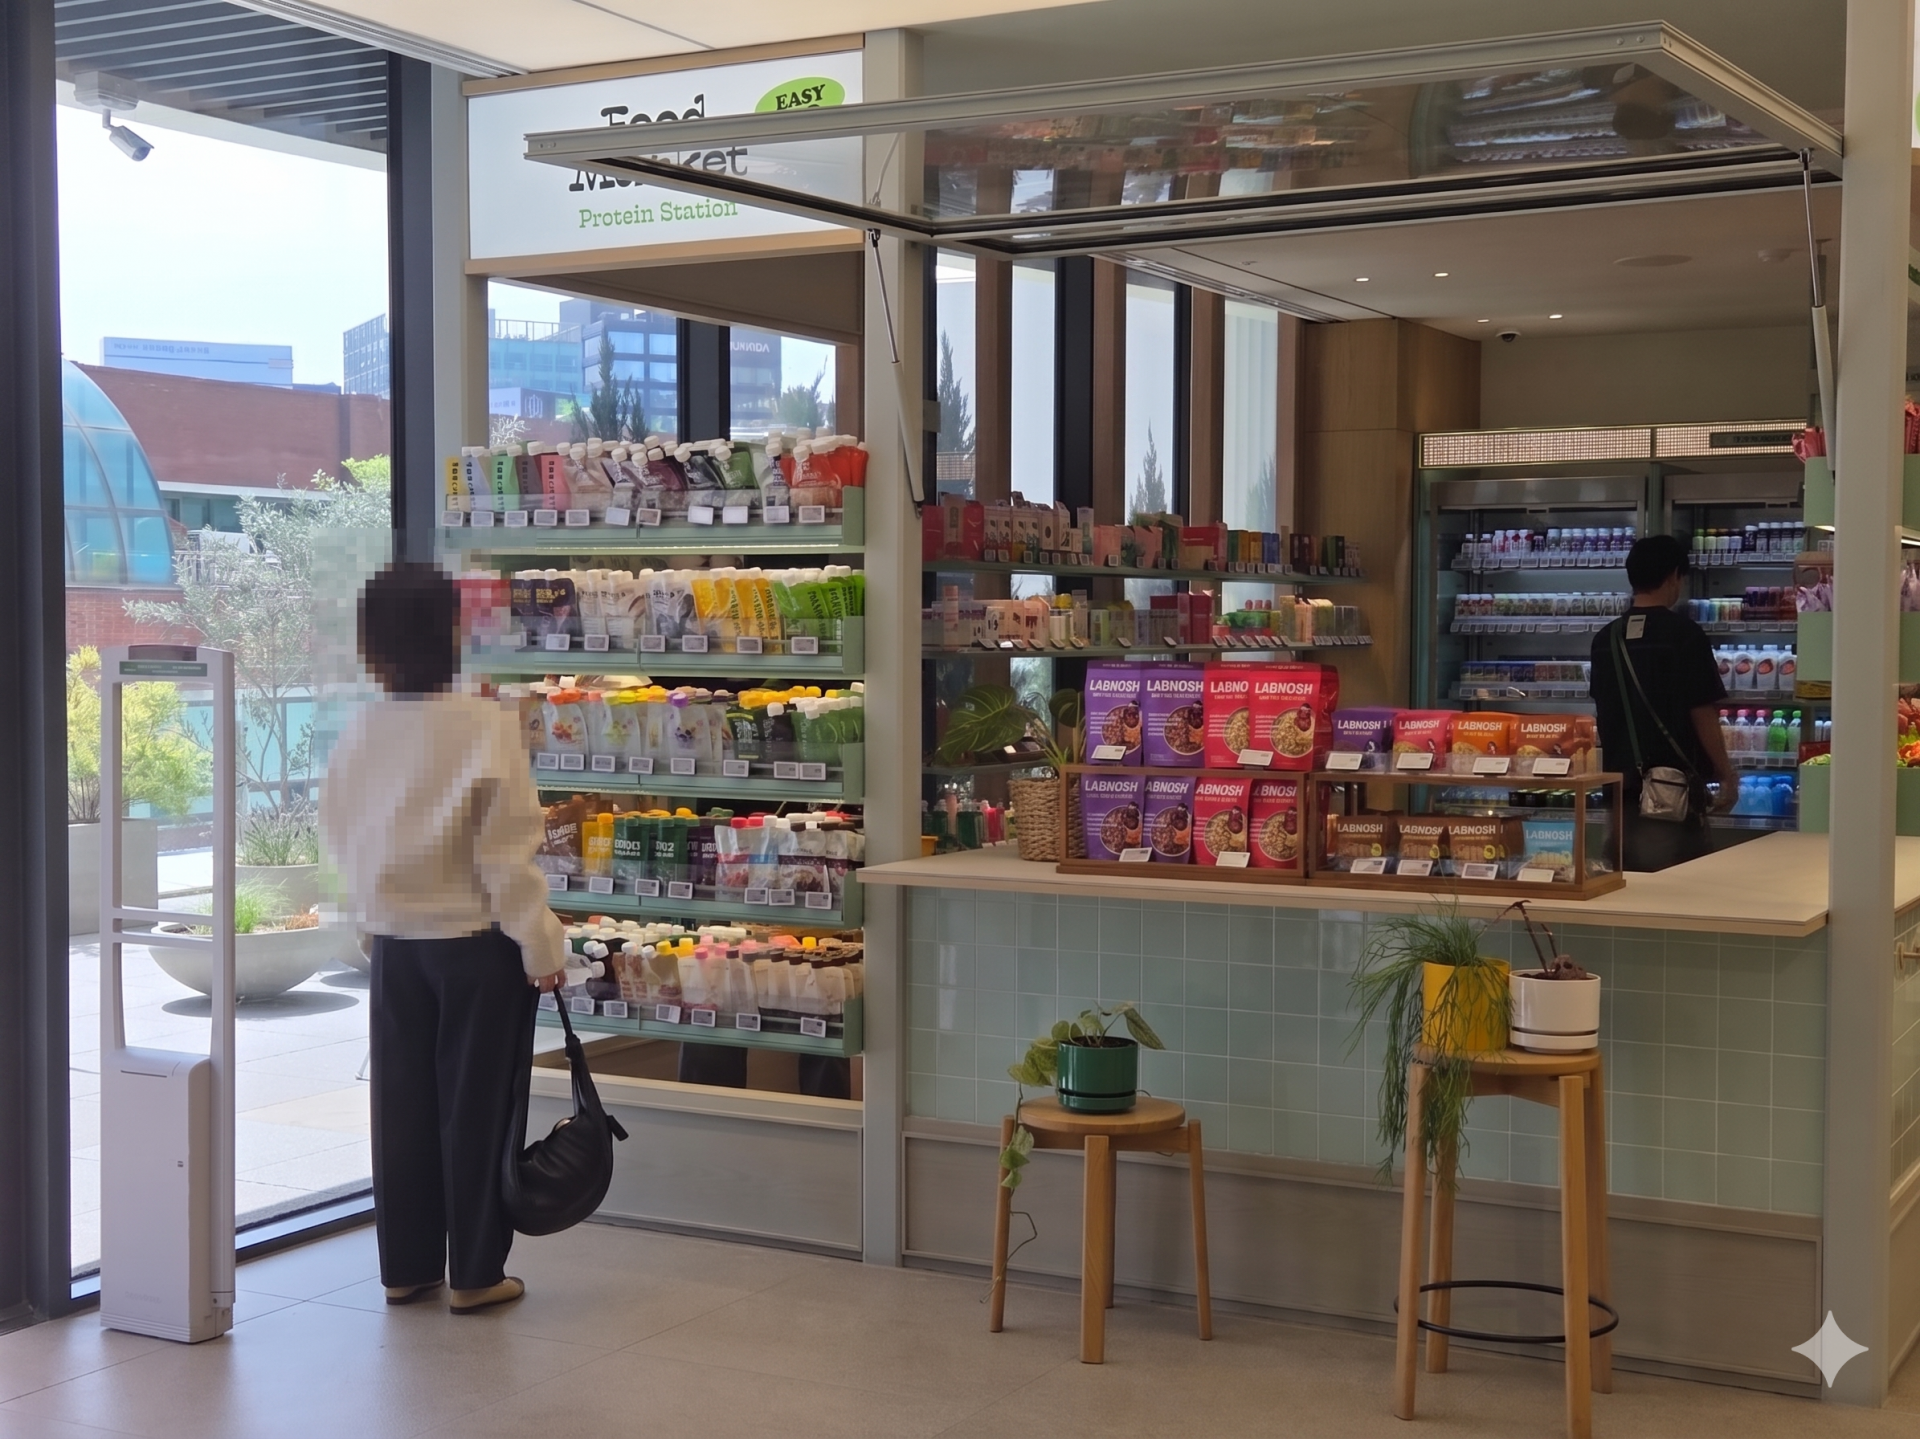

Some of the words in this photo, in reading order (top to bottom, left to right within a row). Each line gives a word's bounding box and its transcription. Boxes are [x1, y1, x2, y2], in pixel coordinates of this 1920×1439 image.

[776, 84, 826, 110] EASY
[579, 204, 654, 228] Protein
[660, 198, 738, 222] Station
[1089, 679, 1141, 692] LABNOSH
[1146, 679, 1204, 692] LABNOSH
[1254, 682, 1313, 695] LABNOSH
[1338, 720, 1381, 730] LABNOSH
[1399, 720, 1440, 730] LABNOSH
[1458, 721, 1503, 731] LABNOSH
[1521, 723, 1567, 733] LABNOSH
[1085, 780, 1139, 792] LABNOSH
[1337, 823, 1383, 833] LABNOSH
[1448, 825, 1496, 835] LABNOSH
[1525, 830, 1573, 840] LABNOSH
